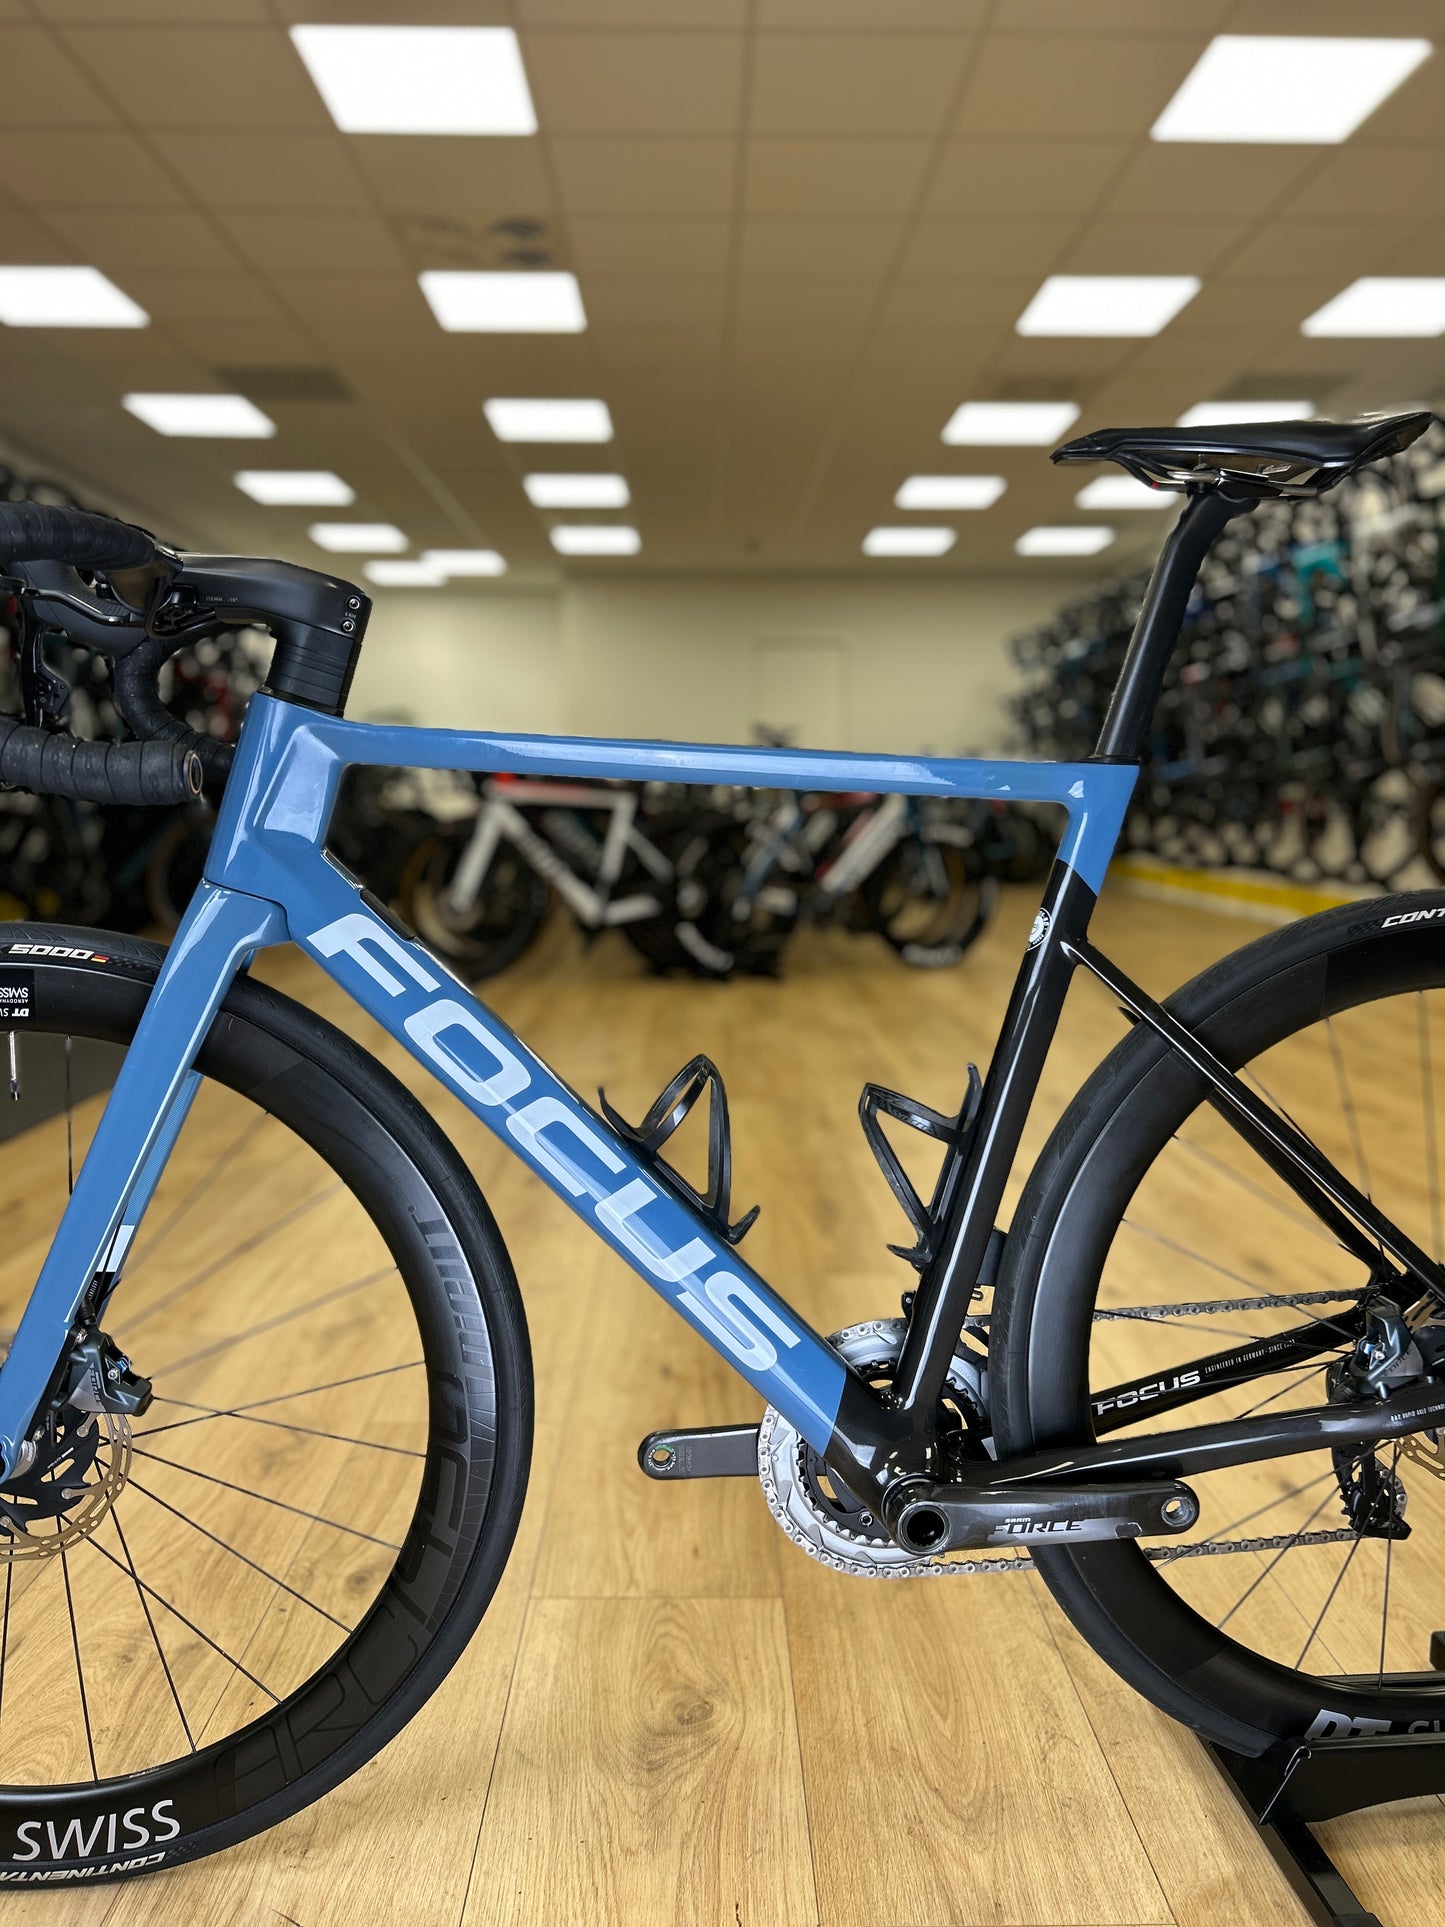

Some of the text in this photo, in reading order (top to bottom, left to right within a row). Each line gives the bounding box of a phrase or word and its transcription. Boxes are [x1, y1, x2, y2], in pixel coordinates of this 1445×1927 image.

[8, 944, 95, 960] 5000
[12, 1008, 30, 1017] DT
[306, 913, 801, 1371] FOCUS
[1204, 1358, 1235, 1374] ENGINEERED
[1235, 1356, 1242, 1364] IN
[1243, 1349, 1265, 1362] GERMANY
[1268, 1343, 1283, 1354] SINCE
[1097, 1370, 1200, 1416] FOCUS
[993, 1519, 1082, 1534] FORCE
[1304, 1709, 1393, 1739] DT
[12, 1799, 181, 1862] SWISS
